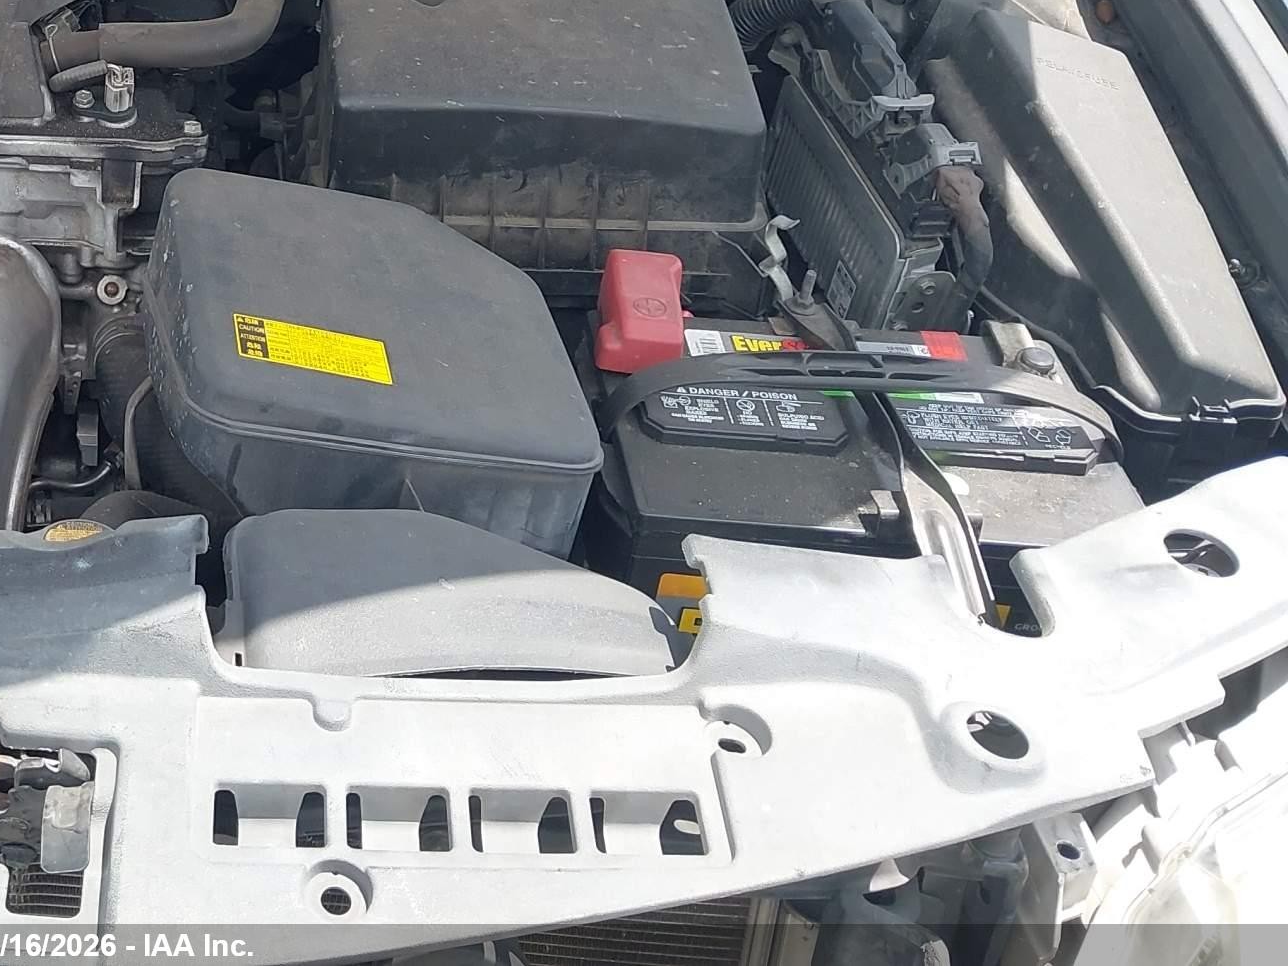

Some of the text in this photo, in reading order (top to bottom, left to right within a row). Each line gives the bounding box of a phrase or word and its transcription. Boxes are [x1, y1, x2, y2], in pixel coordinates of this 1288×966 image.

[239, 323, 265, 333] CAUTION
[689, 386, 739, 398] DANGER
[751, 391, 798, 401] POISON
[1014, 623, 1039, 631] GRO
